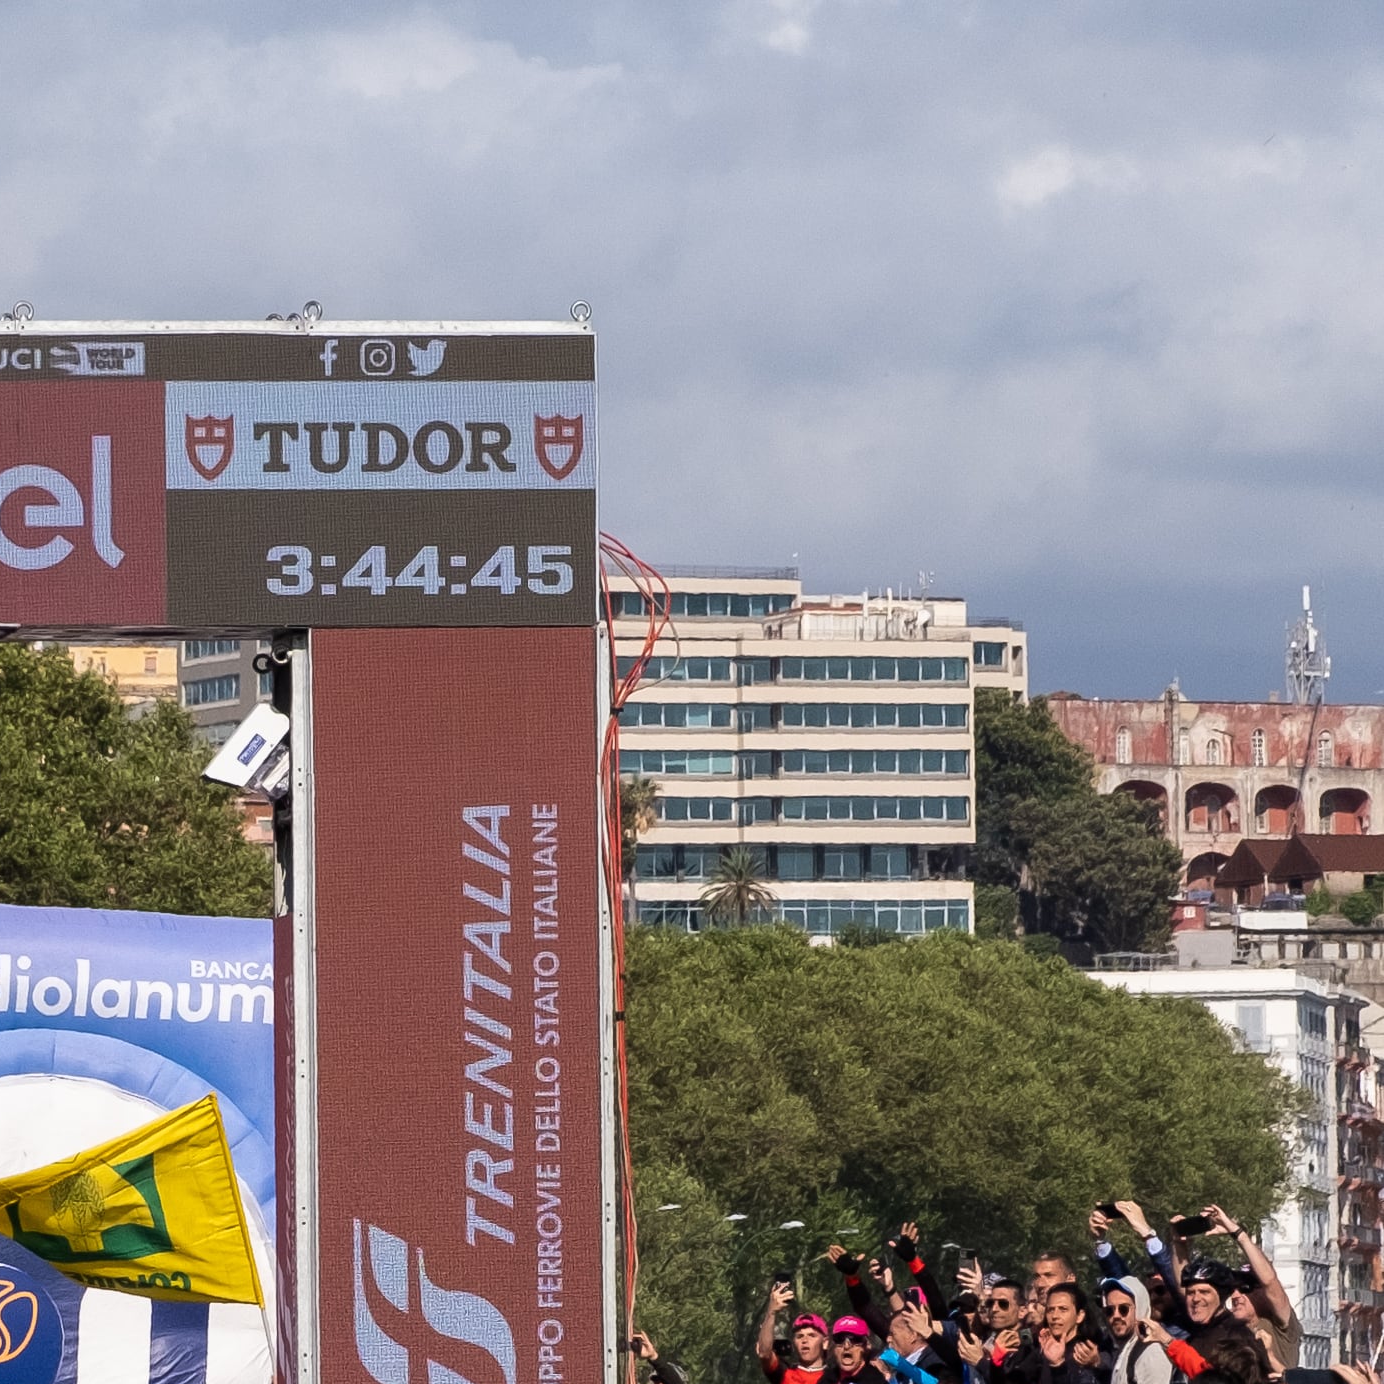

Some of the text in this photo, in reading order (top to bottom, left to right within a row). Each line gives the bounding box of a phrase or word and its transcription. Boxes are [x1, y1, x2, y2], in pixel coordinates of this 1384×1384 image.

[85, 346, 136, 360] WORLD
[87, 358, 126, 370] TOUR
[253, 421, 517, 473] TUDOR
[266, 544, 574, 596] 3:44:45
[531, 803, 559, 947] ITALIANE
[189, 959, 274, 982] BANCA
[532, 951, 561, 1047] STATO
[462, 803, 519, 1247] TRENITALIA
[534, 1052, 562, 1153] DELLO
[535, 1161, 563, 1310] FERROVIE
